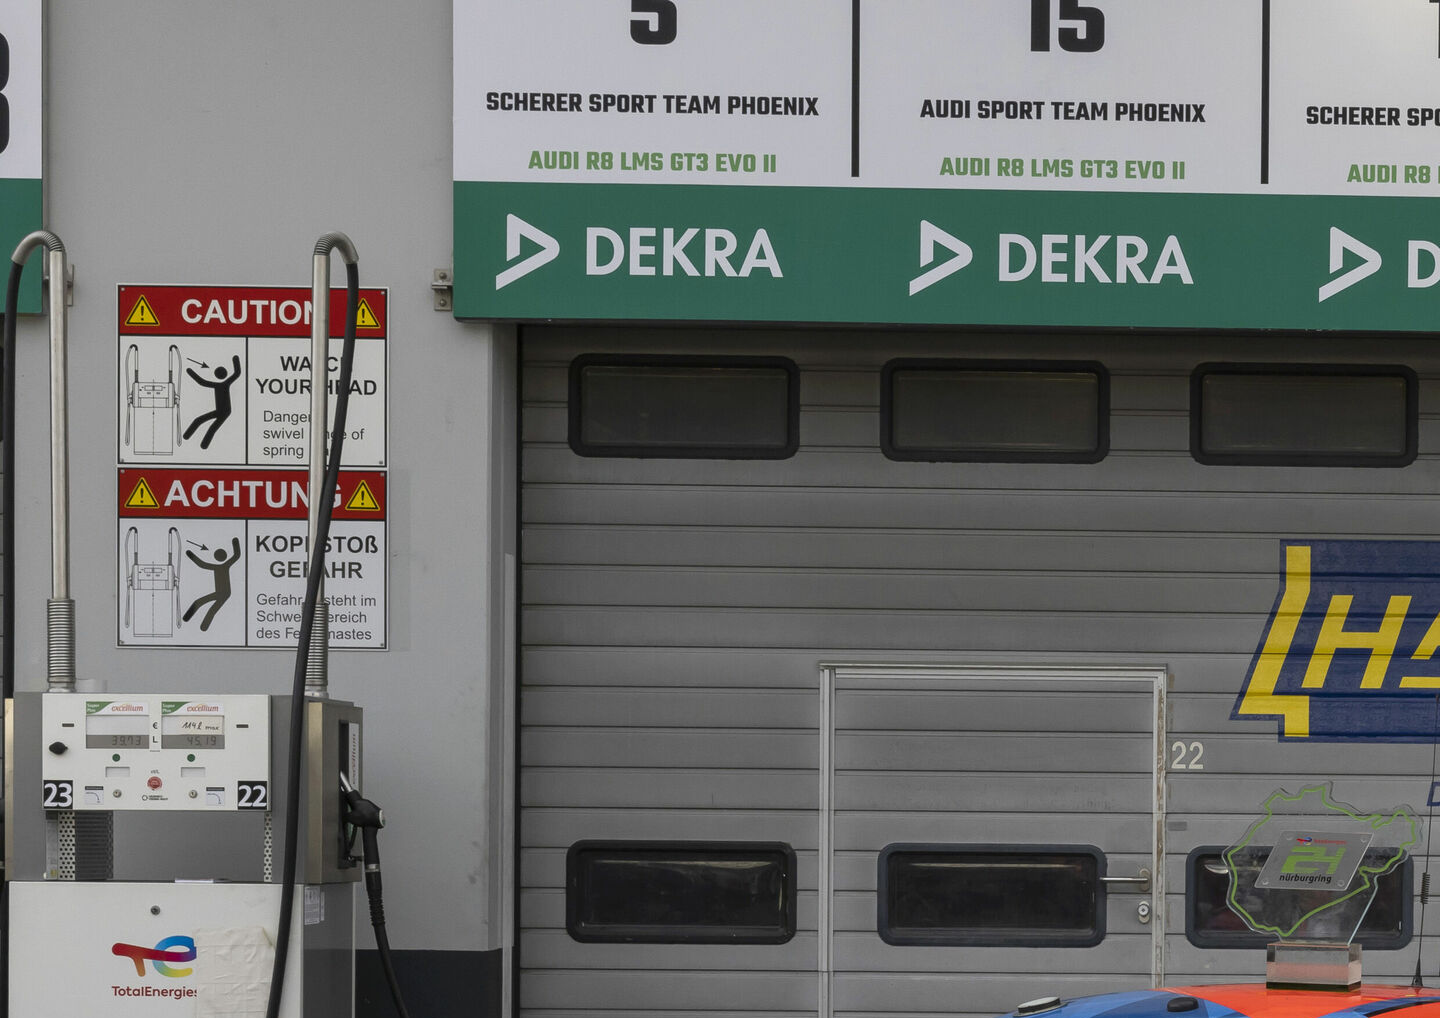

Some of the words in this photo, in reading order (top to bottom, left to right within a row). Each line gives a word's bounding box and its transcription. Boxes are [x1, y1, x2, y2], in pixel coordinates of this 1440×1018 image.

[1030, 0, 1105, 53] 15
[486, 92, 583, 112] SCHERER
[589, 94, 657, 113] SPORT
[663, 95, 721, 114] TEAM
[728, 97, 819, 116] PHOENIX
[920, 99, 971, 119] AUDI
[977, 100, 1044, 120] SPORT
[1051, 101, 1108, 121] TEAM
[1115, 103, 1206, 122] PHOENIX
[1306, 106, 1400, 126] SCHERER
[528, 150, 579, 169] AUDI
[586, 151, 613, 170] R8
[620, 152, 663, 171] LMS
[670, 152, 709, 171] GT3
[716, 153, 757, 172] EVO
[763, 154, 776, 172] II
[939, 158, 990, 176] AUDI
[997, 158, 1024, 177] R8
[1031, 159, 1073, 178] LMS
[1080, 160, 1118, 178] GT3
[1125, 160, 1165, 179] EVO
[1172, 161, 1185, 179] II
[1347, 164, 1397, 183] AUDI
[1404, 165, 1431, 184] R8
[586, 227, 783, 278] DEKRA
[999, 233, 1194, 284] DEKRA
[181, 299, 312, 324] CAUTIO
[256, 379, 311, 394] YOUR
[263, 427, 304, 439] swivel
[351, 428, 365, 440] of
[263, 445, 304, 459] spring
[257, 594, 302, 606] Gefahr
[361, 596, 377, 606] im
[257, 628, 280, 639] des
[111, 704, 144, 712] excellium
[152, 736, 158, 744] L
[1171, 742, 1204, 770] 22
[44, 783, 72, 807] 23
[238, 785, 267, 807] 22
[1279, 872, 1332, 884] nürburgring
